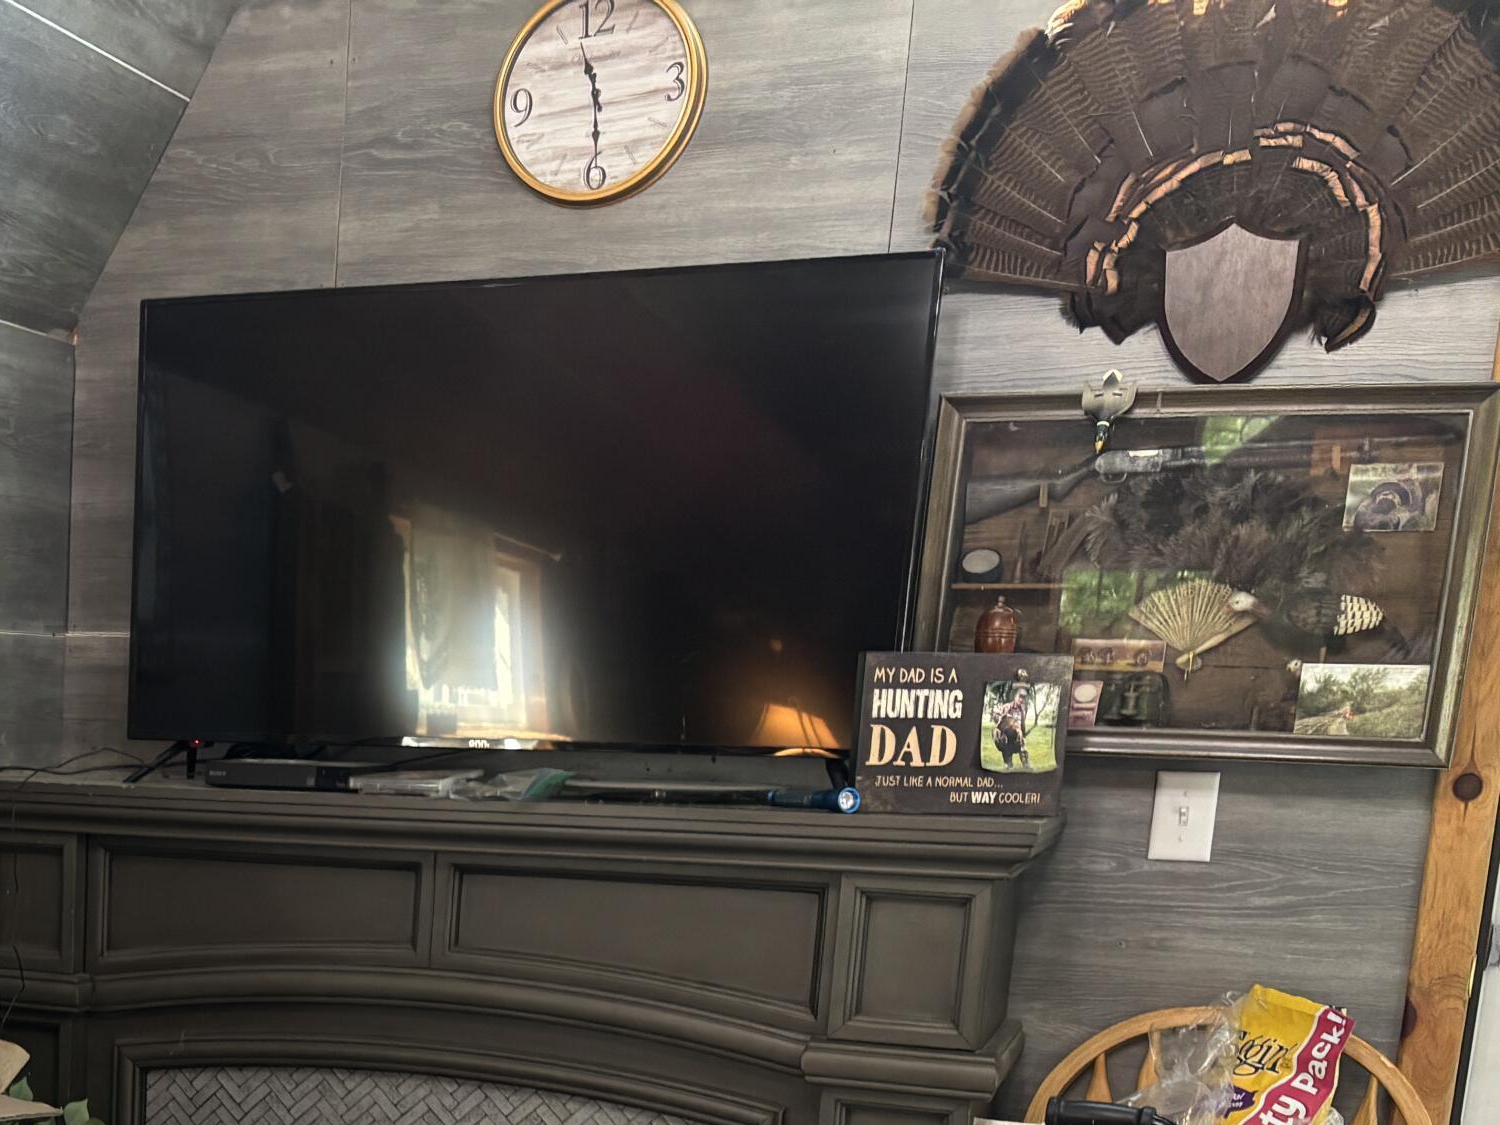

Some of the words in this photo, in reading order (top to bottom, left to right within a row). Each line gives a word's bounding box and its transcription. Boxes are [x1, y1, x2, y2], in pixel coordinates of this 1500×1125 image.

[579, 0, 617, 39] 12
[664, 61, 686, 102] 3
[510, 87, 534, 128] 9
[583, 151, 607, 191] 6
[874, 667, 896, 683] MY
[899, 667, 926, 684] DAD
[930, 667, 944, 684] IS
[947, 668, 959, 684] A
[871, 688, 963, 720] HUNTING
[865, 724, 958, 768] DAD
[875, 775, 902, 788] JUST
[903, 776, 923, 788] LIKE
[926, 776, 934, 788] A
[935, 777, 973, 788] NORMAL
[949, 791, 969, 804] BUT
[971, 790, 997, 805] WAY
[1290, 1011, 1348, 1096] Pack!
